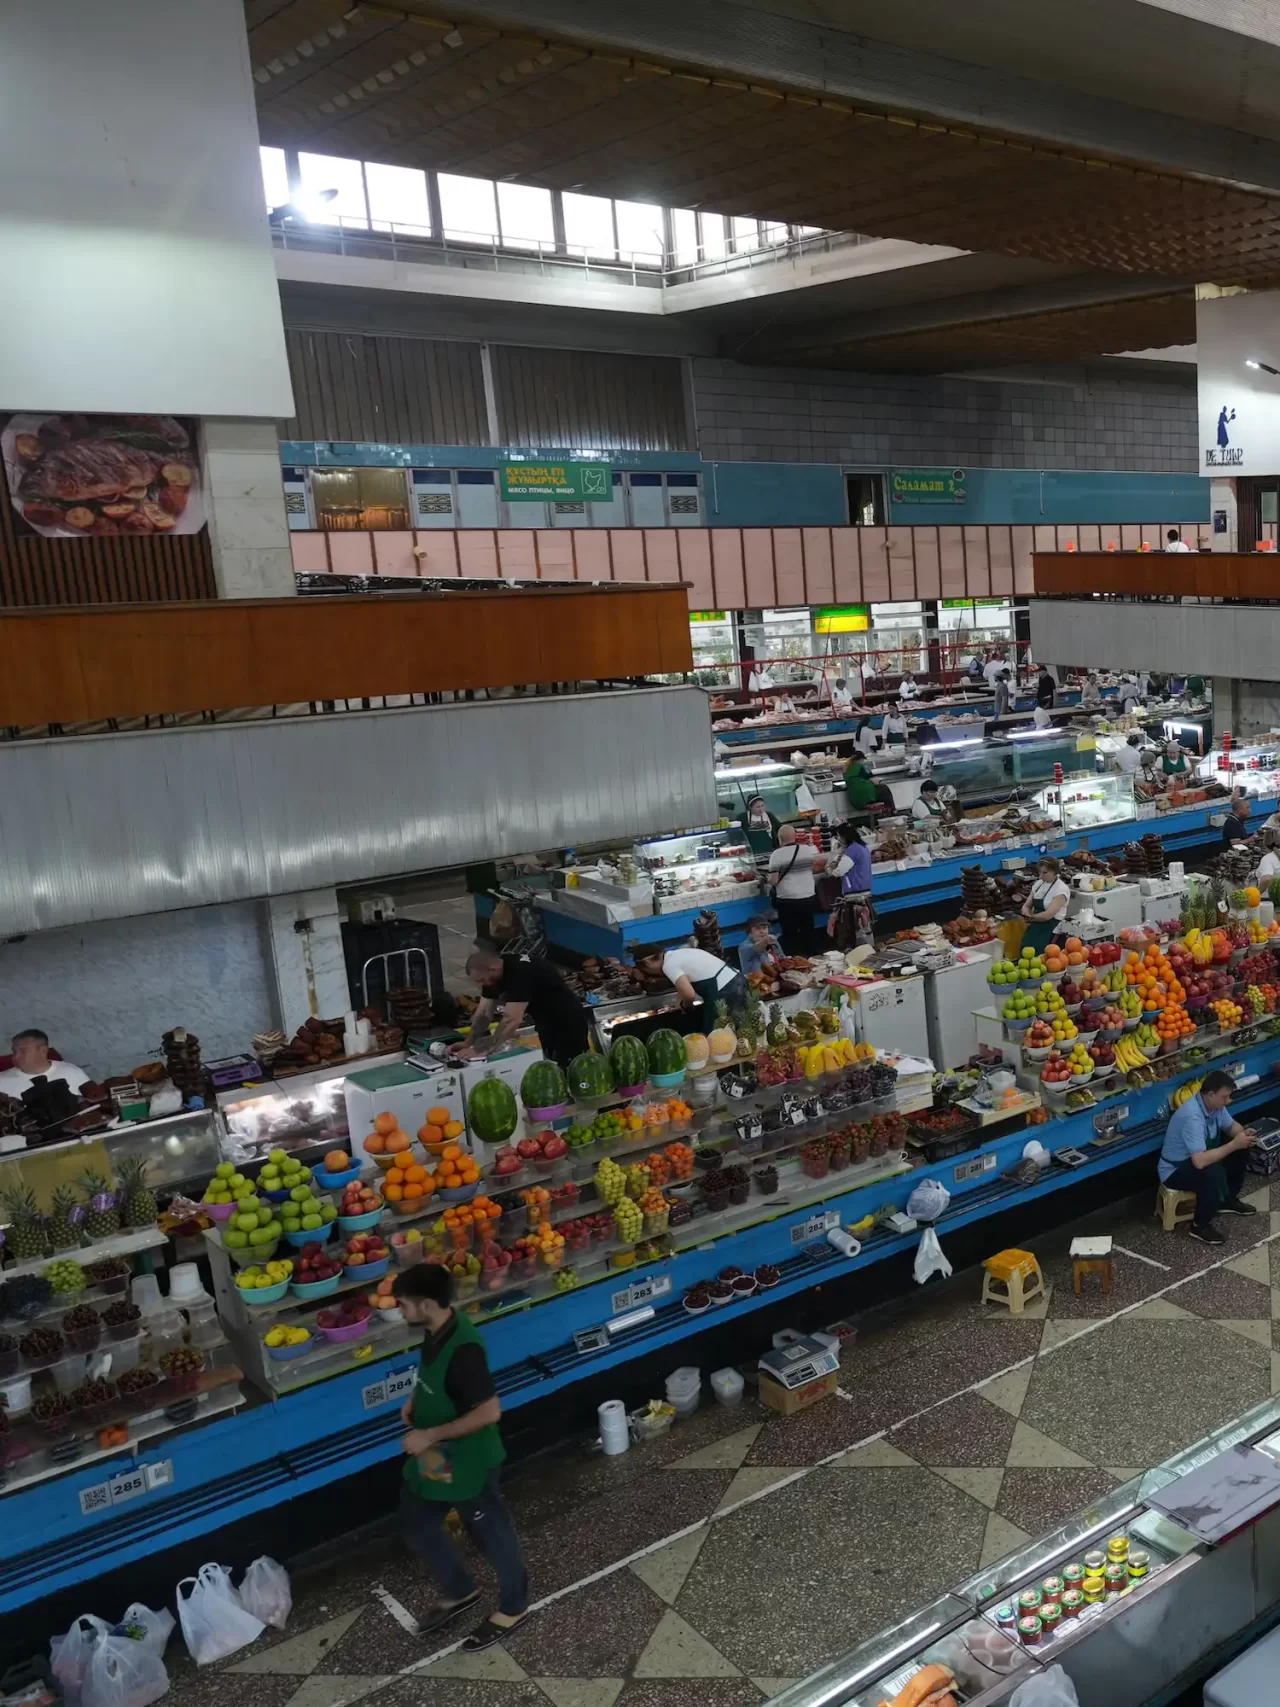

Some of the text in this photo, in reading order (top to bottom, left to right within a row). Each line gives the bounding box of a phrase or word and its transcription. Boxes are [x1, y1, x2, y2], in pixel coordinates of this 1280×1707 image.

[948, 479, 955, 492] 2
[970, 1163, 982, 1173] 281
[808, 1222, 824, 1234] 282
[633, 1286, 652, 1300] 283
[388, 1378, 413, 1393] 284
[114, 1478, 142, 1496] 285
